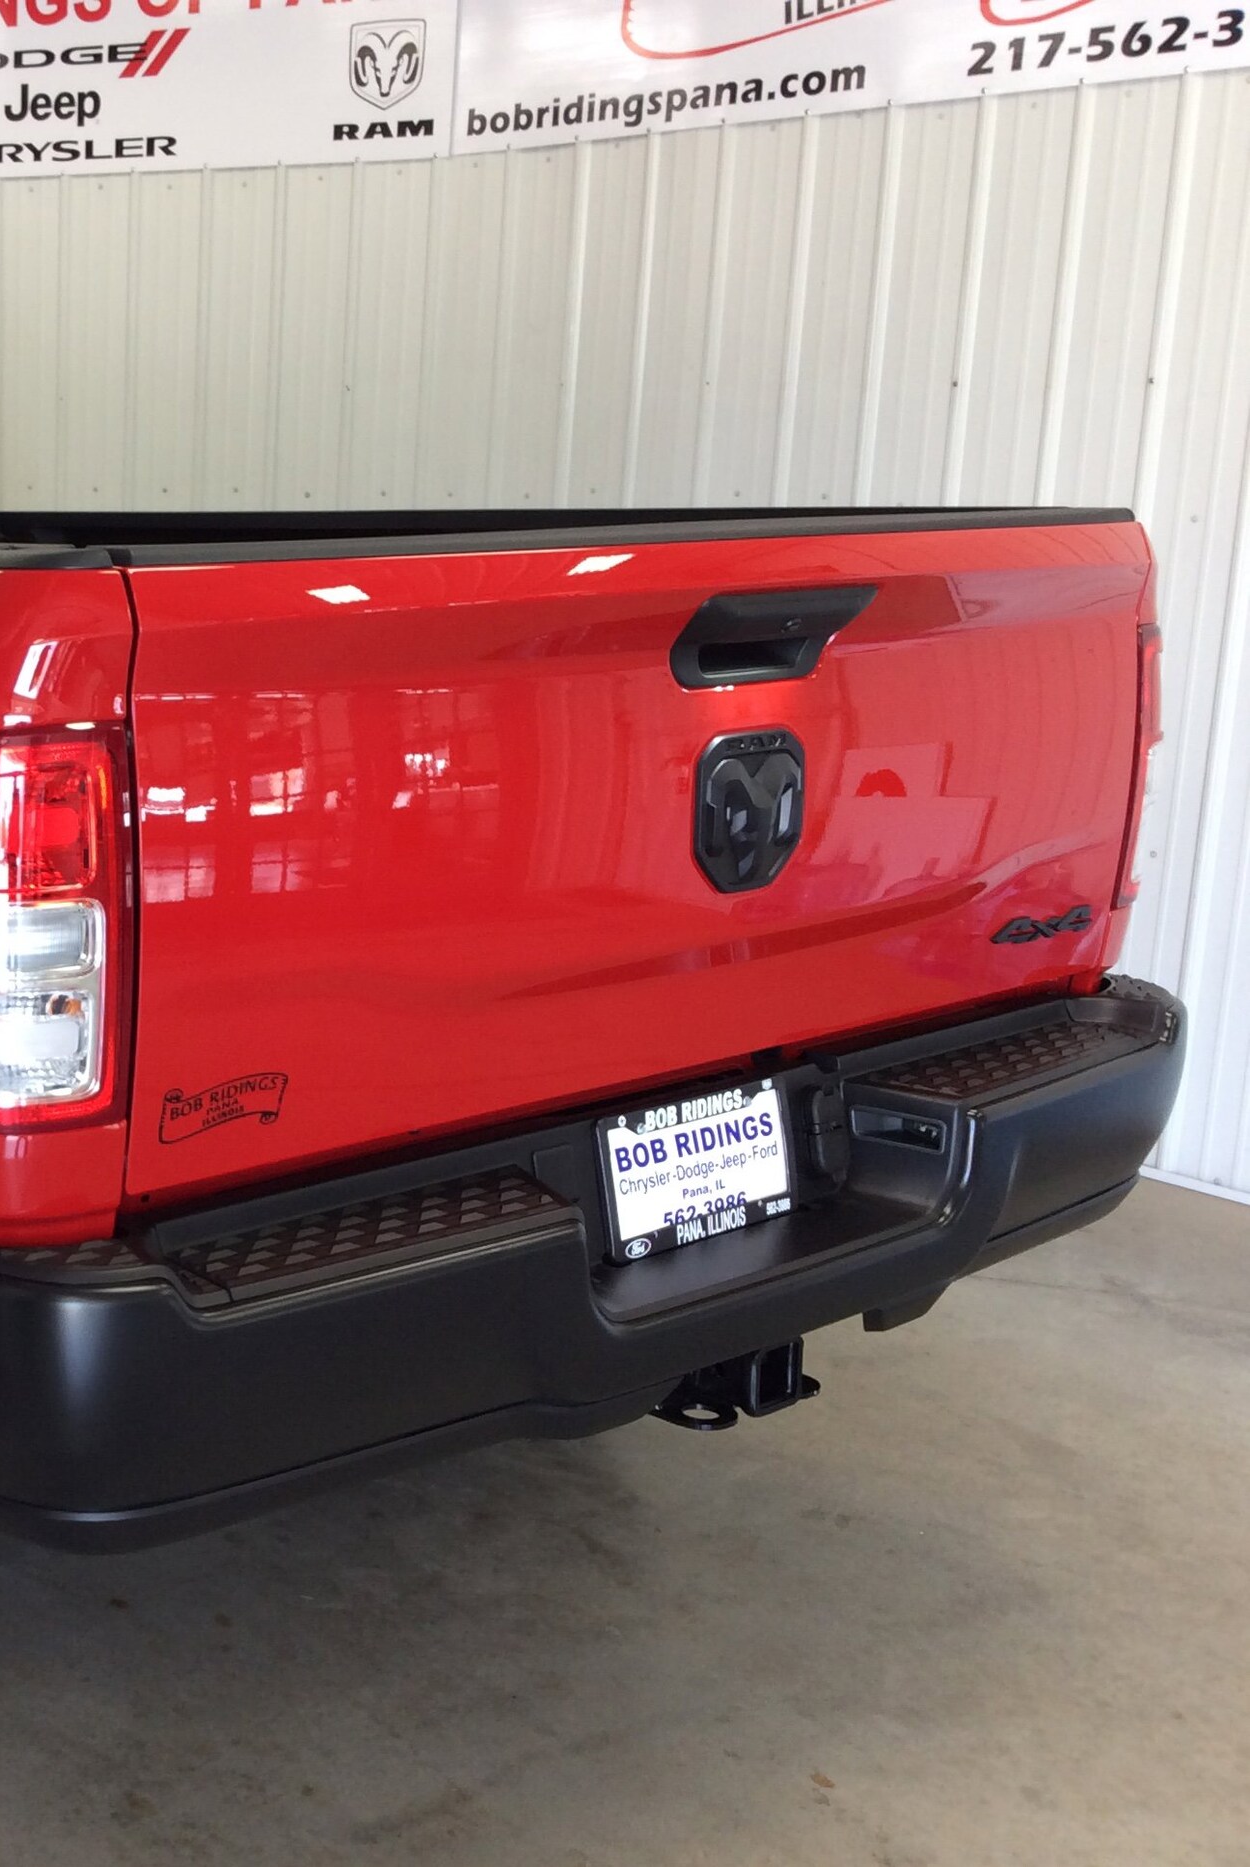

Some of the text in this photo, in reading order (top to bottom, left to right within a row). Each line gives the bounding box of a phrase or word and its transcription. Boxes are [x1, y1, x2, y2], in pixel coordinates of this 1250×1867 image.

[4, 84, 101, 126] Jeep
[467, 64, 867, 136] bobridingspana.com
[333, 118, 435, 141] RAM
[169, 1076, 279, 1120] BOB RIDINGS
[644, 1088, 744, 1132] BOB RIDINGS
[614, 1112, 774, 1173] BOB RIDINGS
[681, 1178, 726, 1200] Pana, IL
[707, 1206, 747, 1236] ILLINOIS
